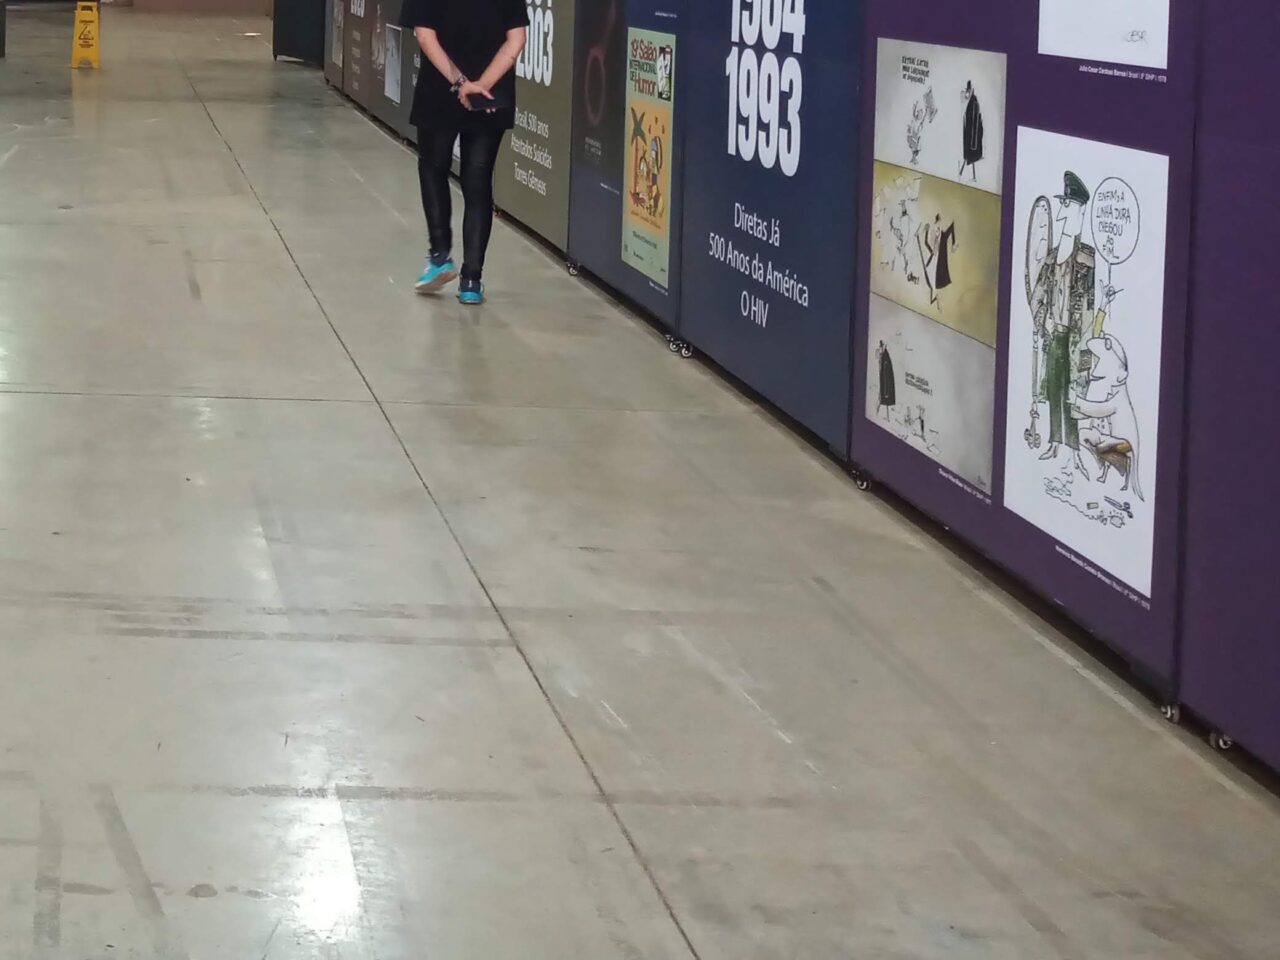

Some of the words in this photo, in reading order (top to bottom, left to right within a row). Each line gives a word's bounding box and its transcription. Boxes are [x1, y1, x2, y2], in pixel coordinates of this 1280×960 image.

[516, 6, 554, 88] 003
[538, 120, 549, 140] anos
[726, 46, 802, 177] 1993
[734, 202, 768, 241] Diretas
[769, 218, 780, 248] Já
[709, 232, 725, 261] 500
[726, 241, 750, 275] Anos
[751, 252, 764, 283] da
[766, 261, 809, 308] América
[741, 291, 750, 316] O
[751, 295, 769, 328] HIV
